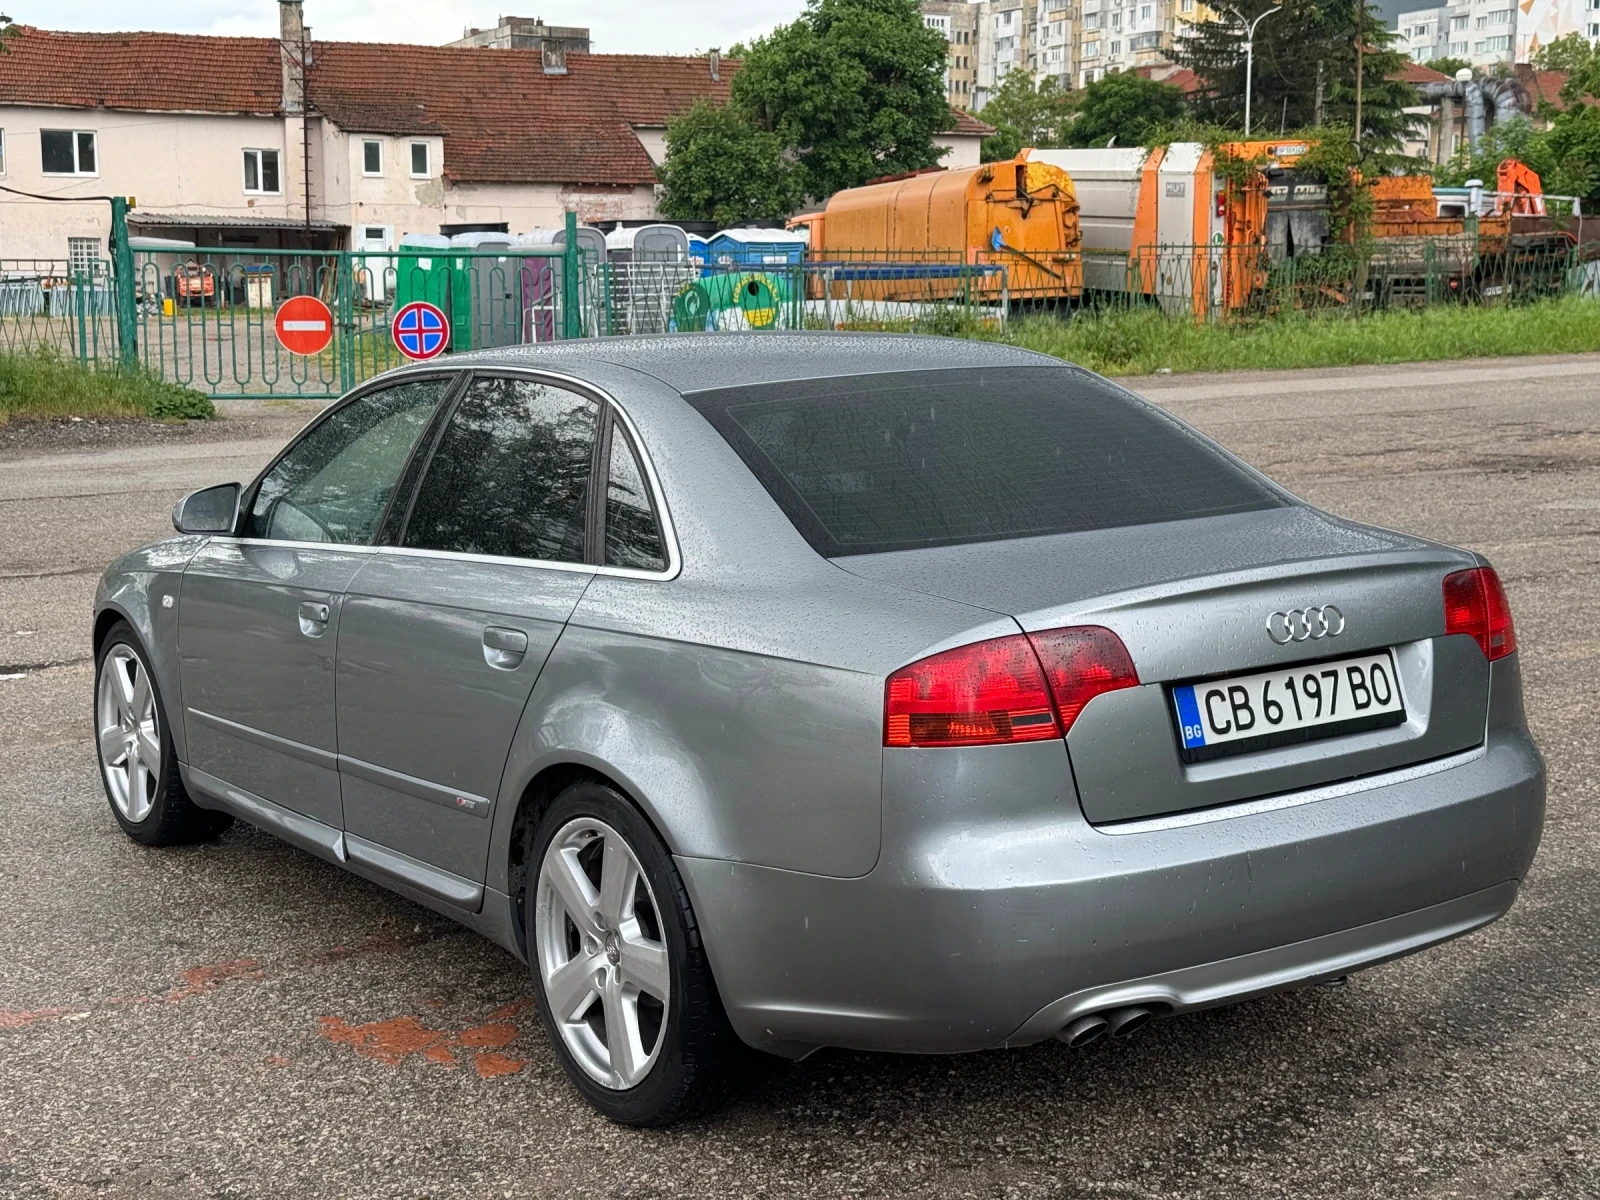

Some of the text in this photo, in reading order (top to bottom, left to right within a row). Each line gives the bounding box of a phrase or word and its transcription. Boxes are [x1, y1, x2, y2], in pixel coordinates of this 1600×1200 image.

[1166, 184, 1185, 193] MUT
[1296, 187, 1325, 196] MUT
[1205, 663, 1392, 735] CB 6197 BO
[1184, 724, 1202, 740] BG
